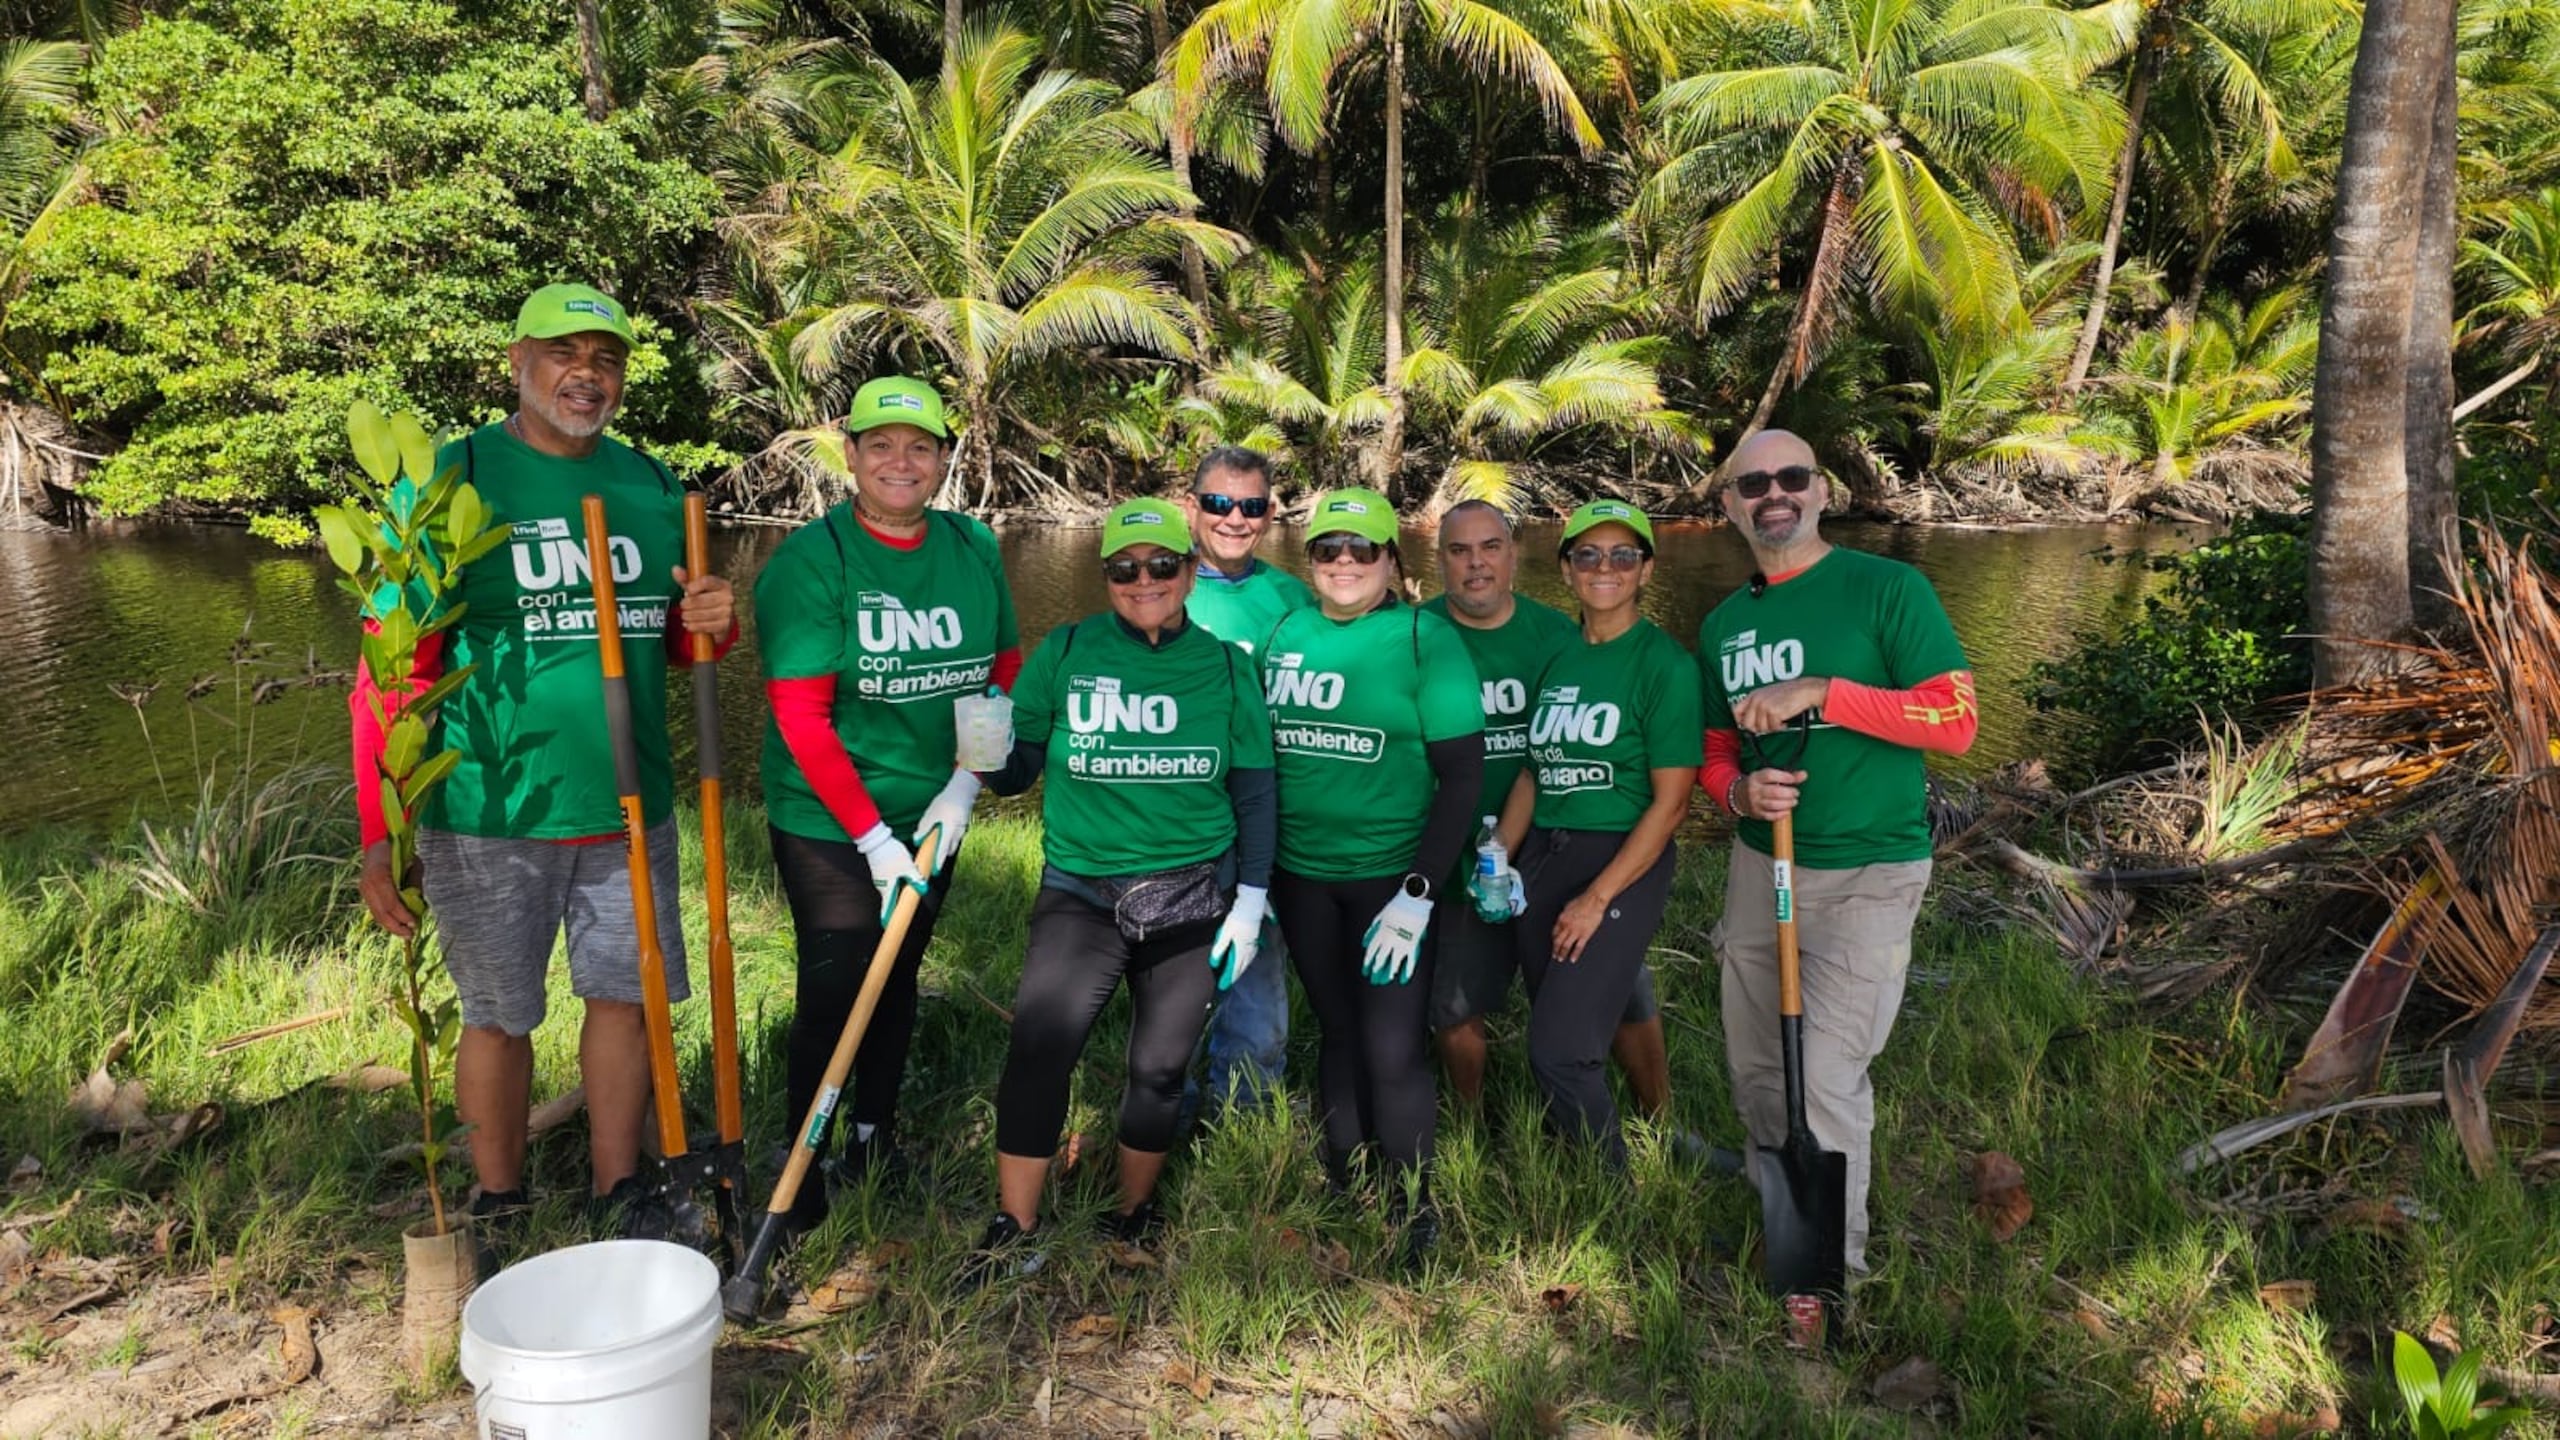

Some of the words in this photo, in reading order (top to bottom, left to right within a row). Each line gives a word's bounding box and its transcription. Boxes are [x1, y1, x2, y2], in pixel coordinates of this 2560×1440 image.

[511, 535, 642, 590] UNO
[518, 592, 567, 608] con
[524, 609, 551, 631] el
[556, 604, 666, 630] amiente
[857, 607, 962, 652] UNO
[858, 655, 901, 672] con
[1721, 639, 1804, 692] UNO
[858, 676, 883, 694] el
[1480, 678, 1526, 715] NO
[1067, 693, 1178, 734] UNO
[1529, 701, 1621, 746] UNO
[1068, 733, 1105, 750] con
[1068, 752, 1087, 774] el
[1090, 754, 1212, 775] ambiente
